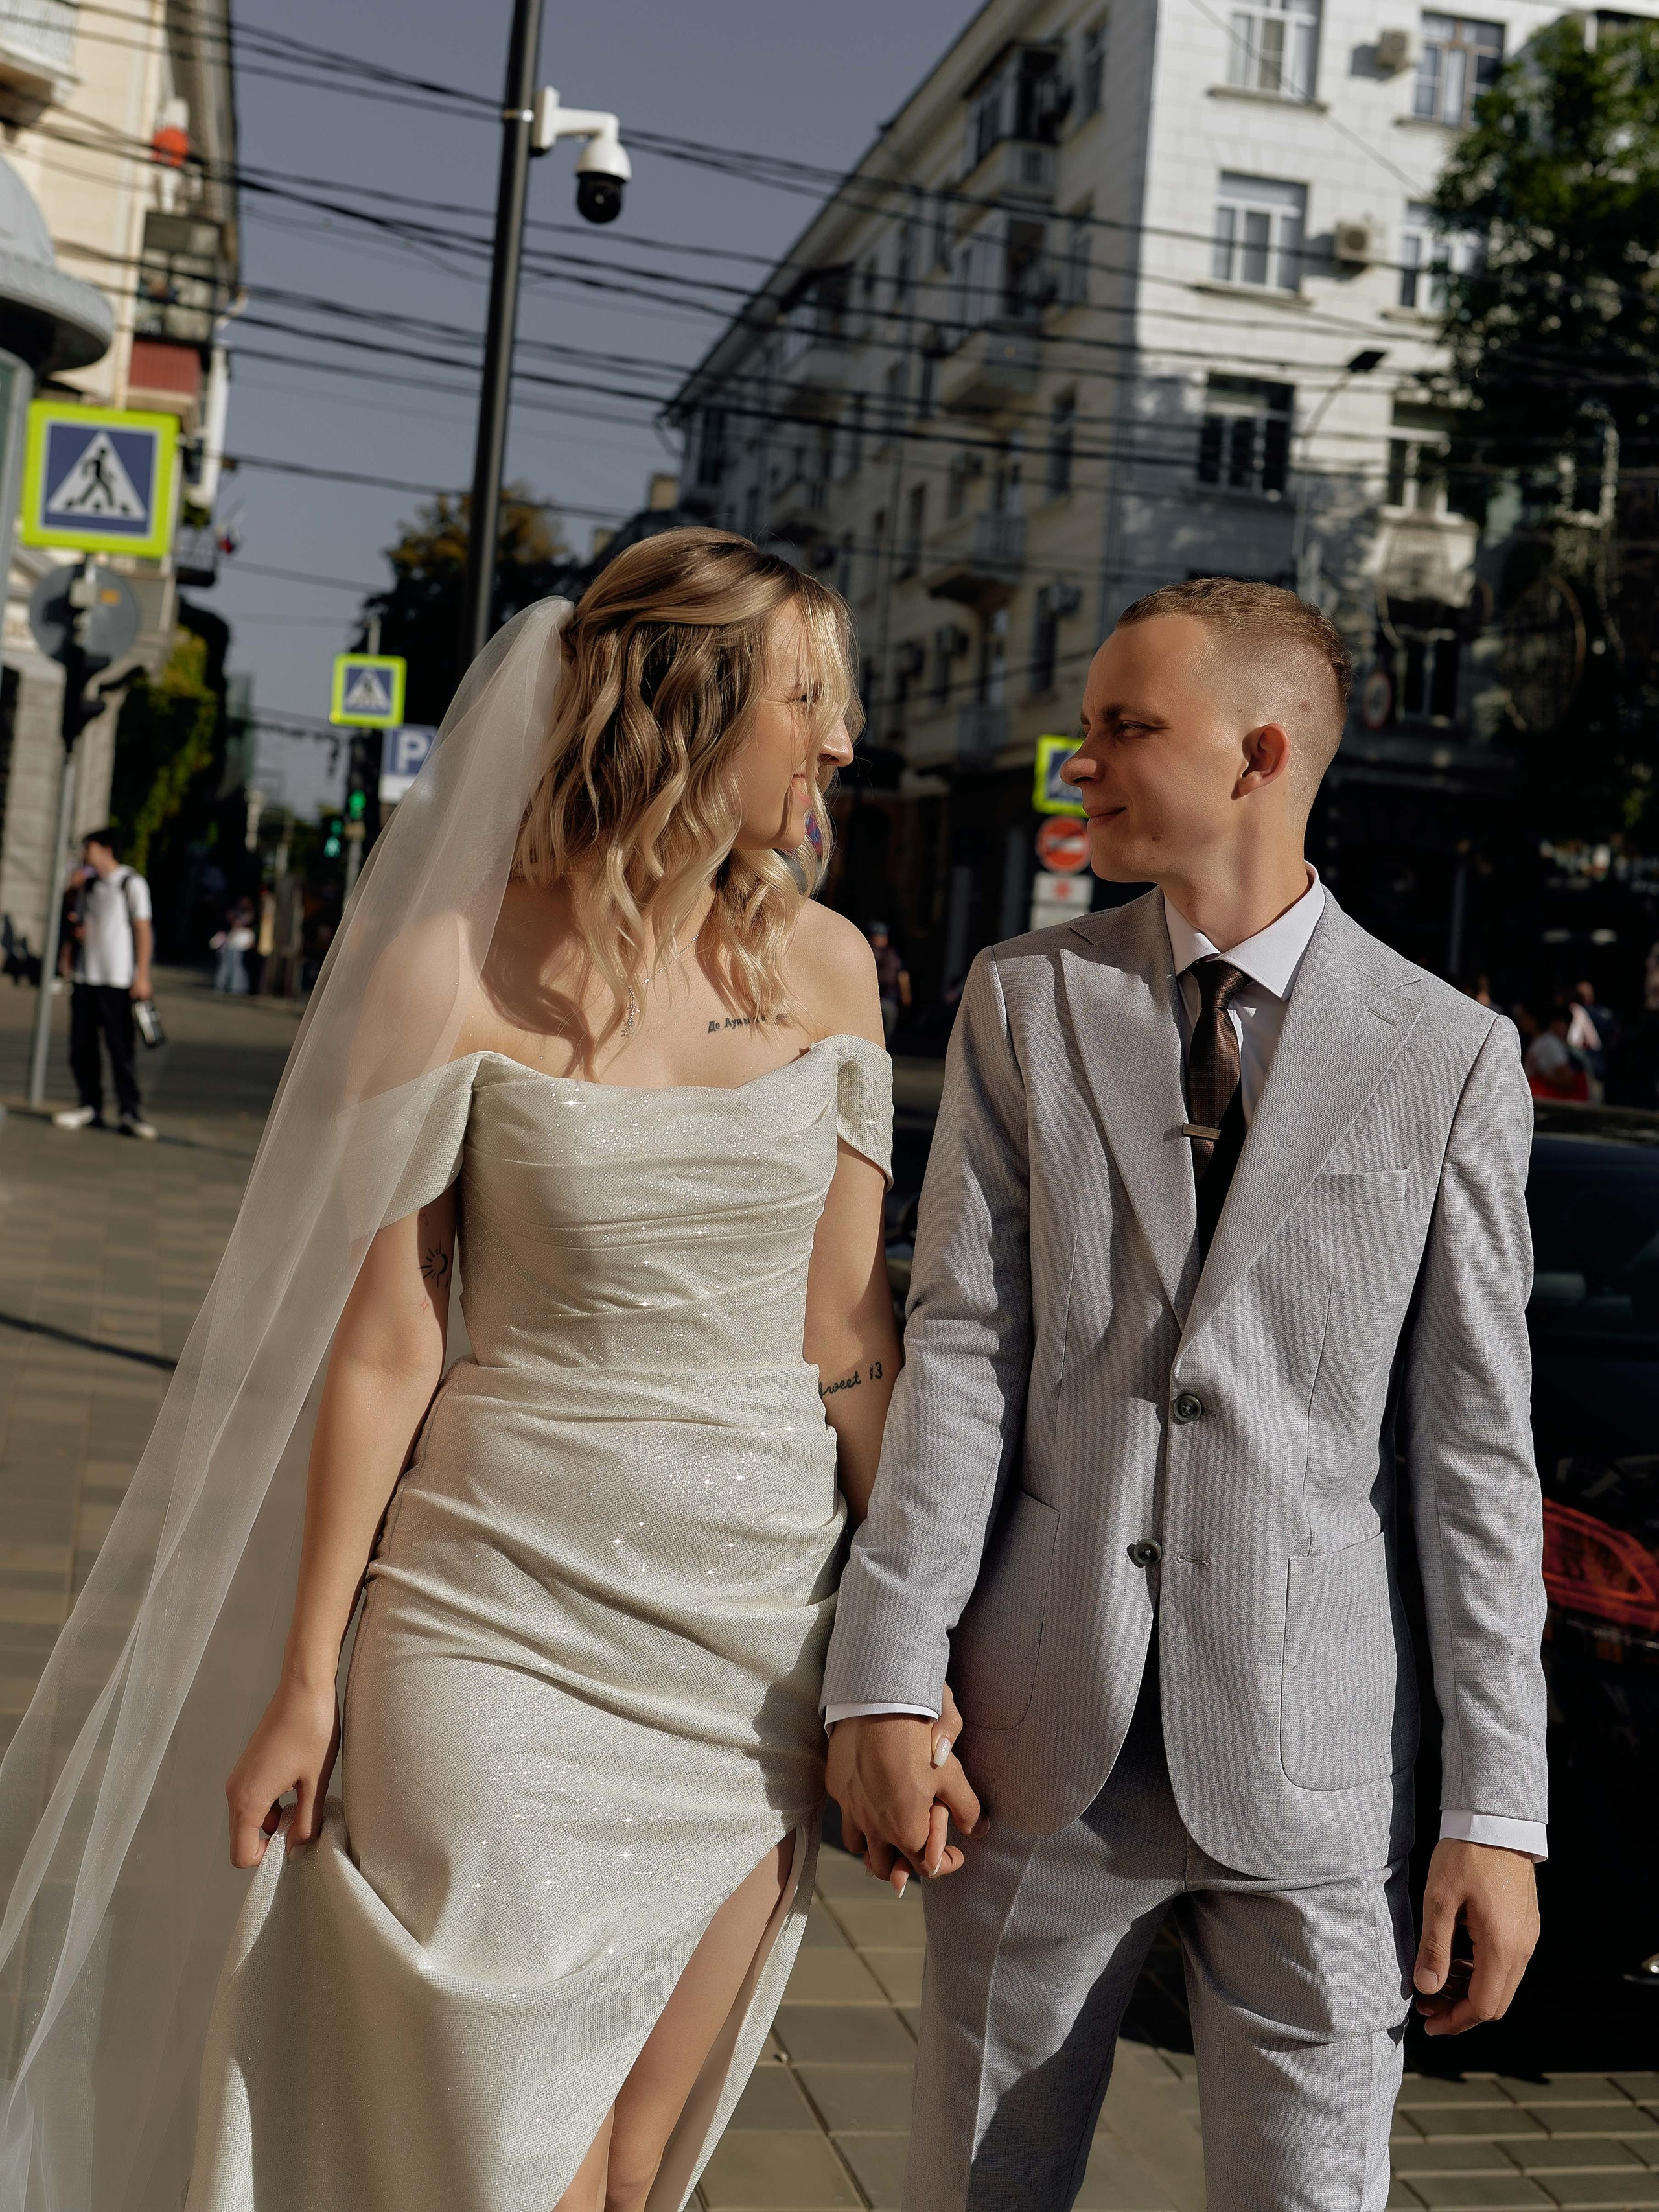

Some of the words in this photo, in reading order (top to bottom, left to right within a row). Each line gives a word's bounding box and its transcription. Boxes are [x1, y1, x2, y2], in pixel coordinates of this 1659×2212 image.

[397, 732, 428, 771] P
[707, 1020, 720, 1034] До
[724, 1018, 750, 1029] Луны
[870, 1362, 883, 1380] 13
